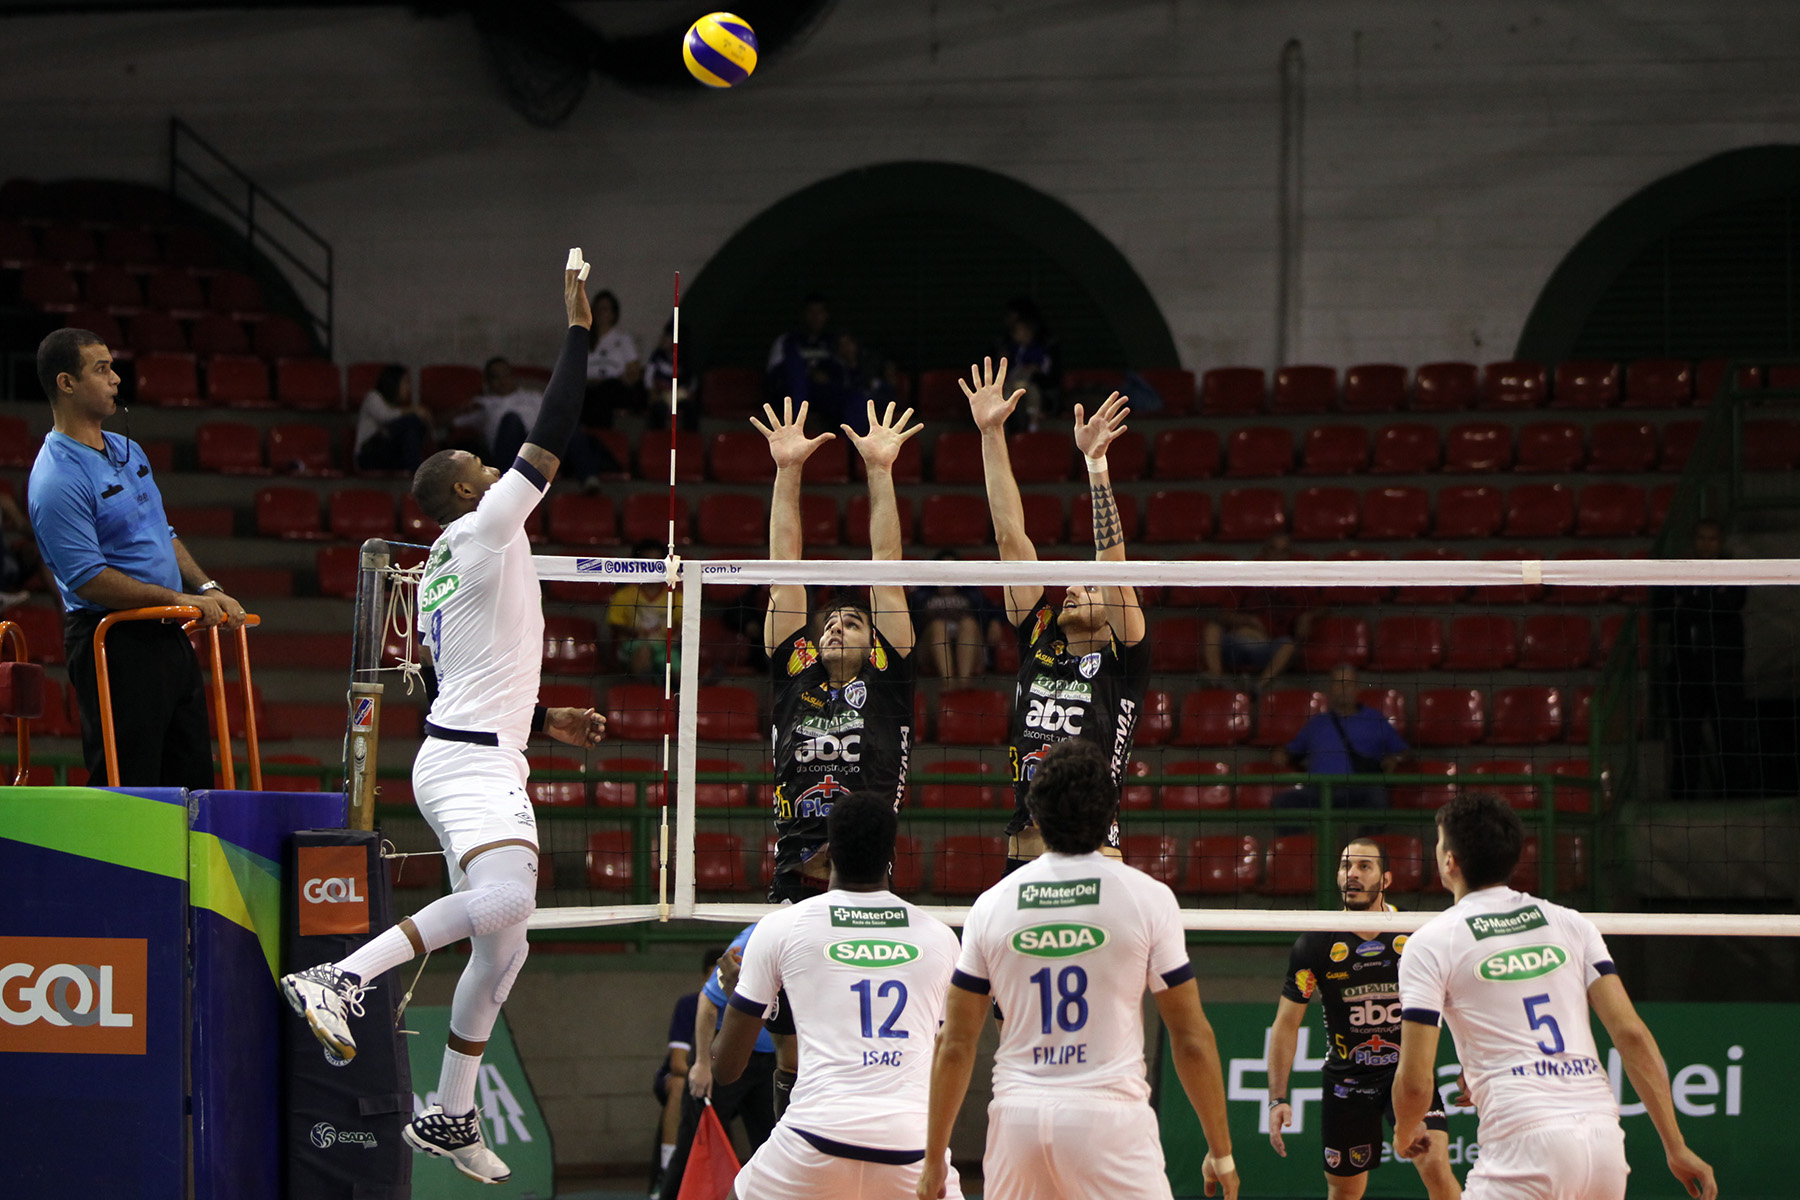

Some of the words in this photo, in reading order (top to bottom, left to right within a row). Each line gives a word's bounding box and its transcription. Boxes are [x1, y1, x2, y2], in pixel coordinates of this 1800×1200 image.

[431, 608, 442, 663] 9
[1025, 698, 1085, 735] abc
[808, 764, 860, 775] construção
[303, 877, 365, 904] GOL
[1039, 883, 1097, 899] MaterDei
[851, 910, 905, 920] MaterDei
[1488, 909, 1542, 930] MaterDei
[835, 943, 911, 961] SADA
[1019, 928, 1097, 950] SADA
[1486, 947, 1561, 977] SADA
[0, 962, 133, 1027] GOL
[1029, 964, 1089, 1034] 18
[849, 978, 910, 1039] 12
[1348, 999, 1402, 1026] abc
[1522, 992, 1566, 1056] 5
[863, 1050, 903, 1067] ISAC
[1032, 1043, 1088, 1066] FILIPE
[1335, 1033, 1348, 1060] 5
[338, 1131, 376, 1144] SADA
